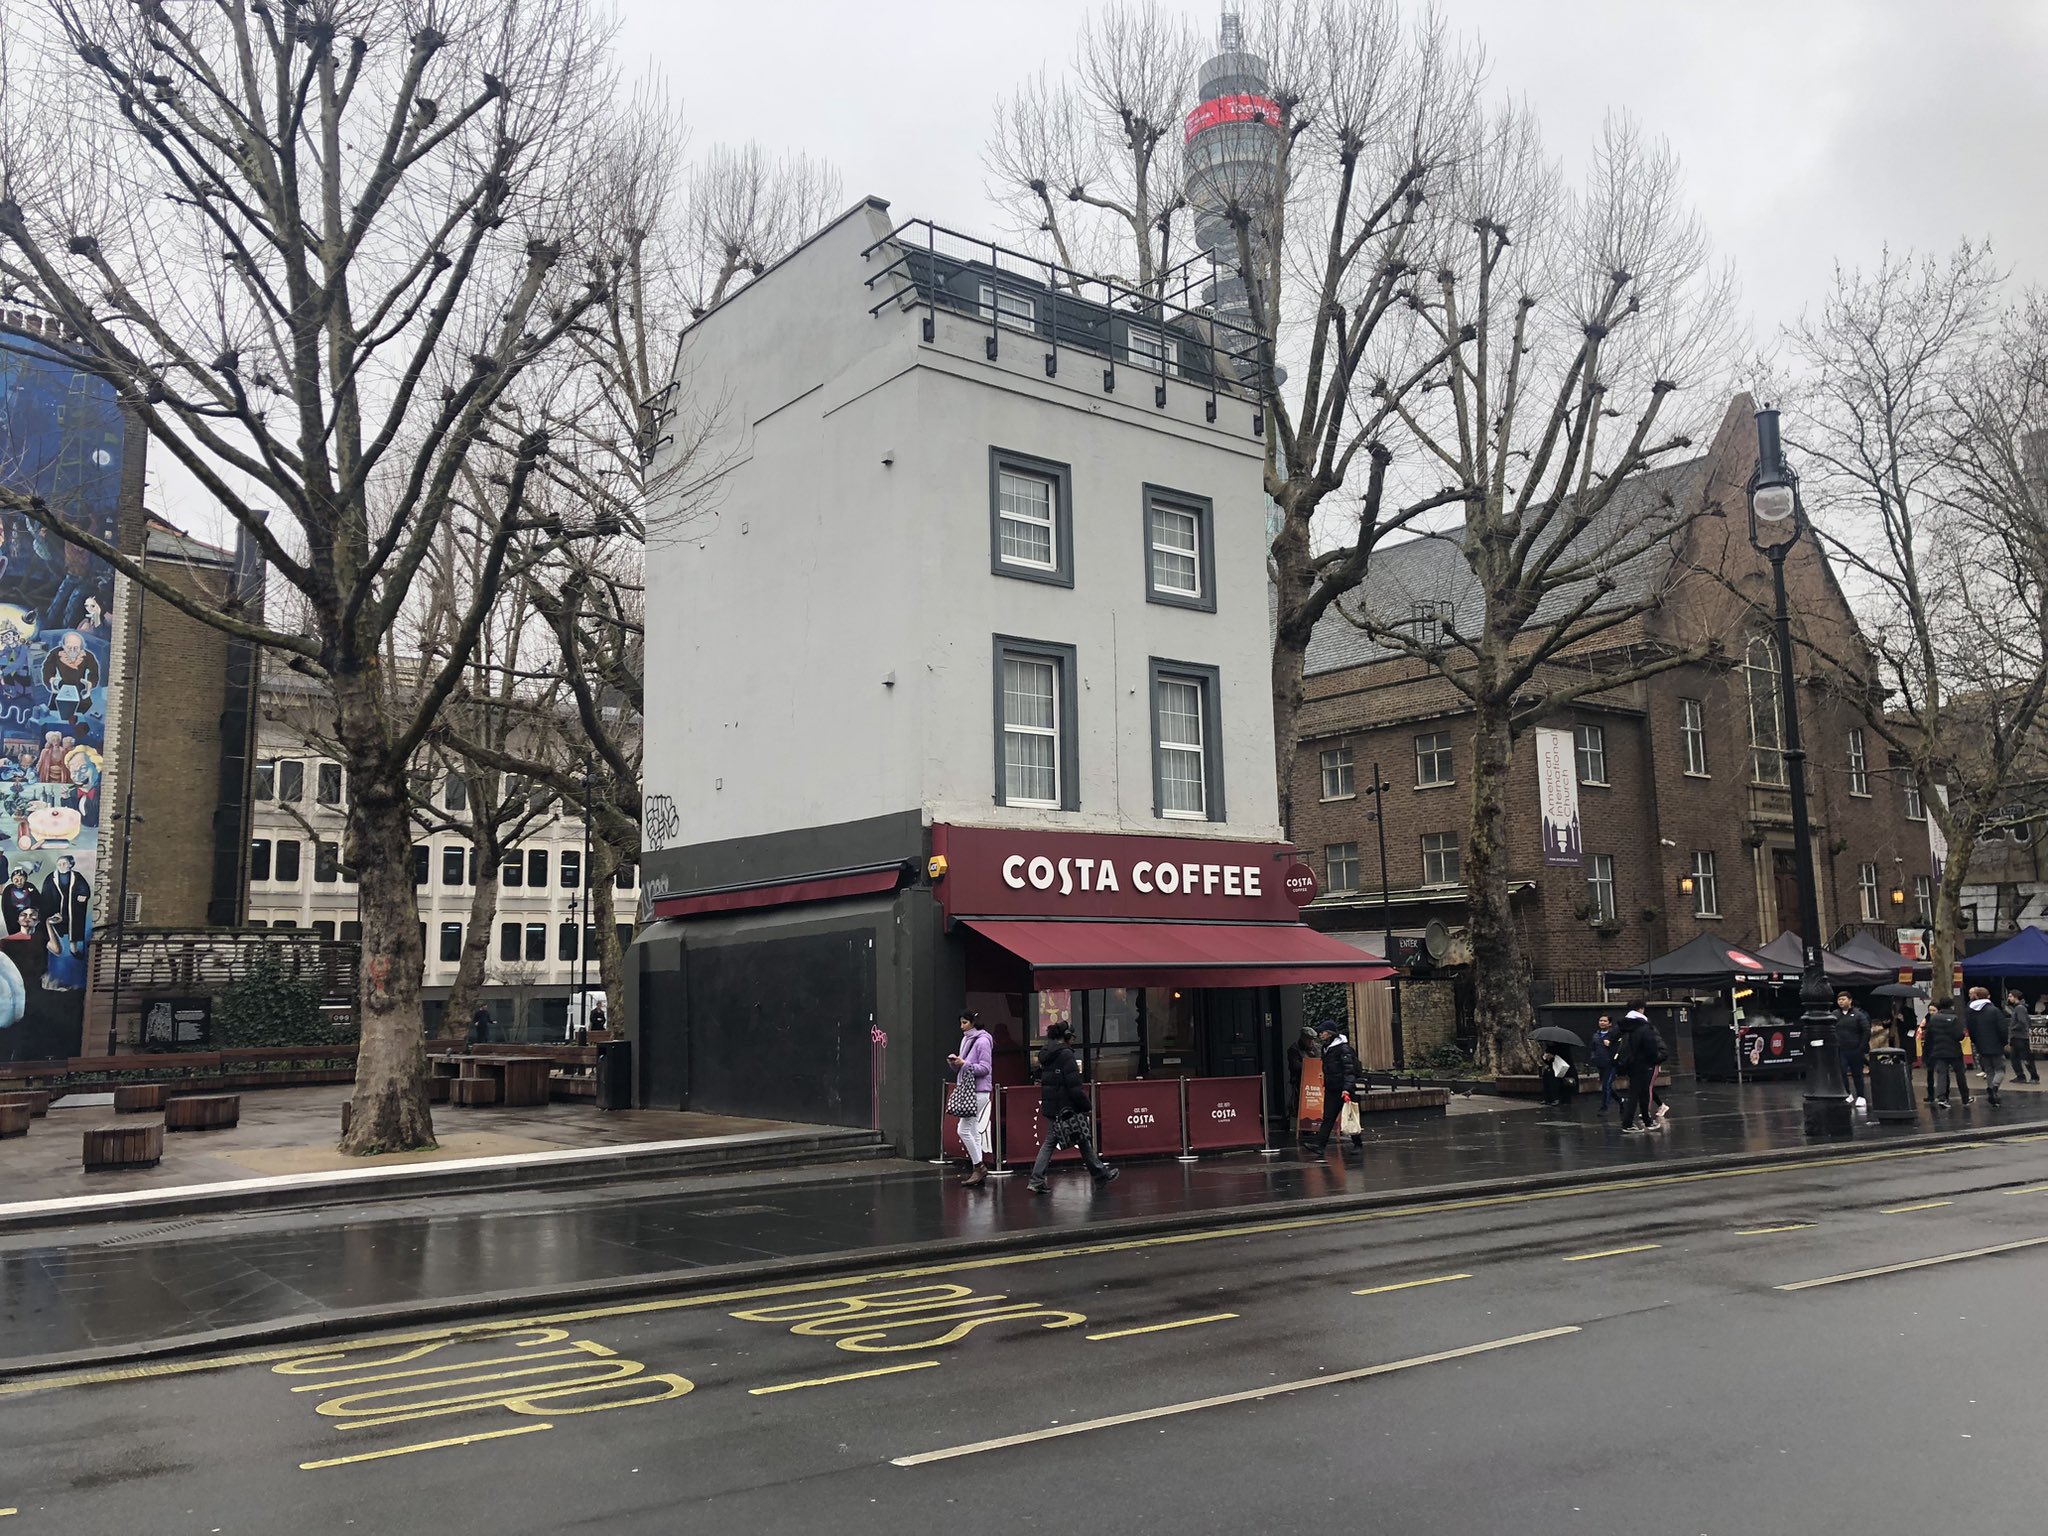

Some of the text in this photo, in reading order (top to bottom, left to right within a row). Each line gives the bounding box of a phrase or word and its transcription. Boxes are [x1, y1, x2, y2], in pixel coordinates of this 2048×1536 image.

[1545, 751, 1554, 816] American
[1551, 733, 1563, 817] International
[1561, 769, 1571, 817] Church
[1002, 854, 1263, 897] COSTA COFFEE
[1286, 877, 1313, 887] COSTA
[1399, 939, 1418, 948] ENTER
[1127, 1114, 1155, 1125] COSTA
[1211, 1109, 1237, 1119] COSTA
[728, 1283, 1087, 1353] BUS
[270, 1327, 696, 1431] STOP
